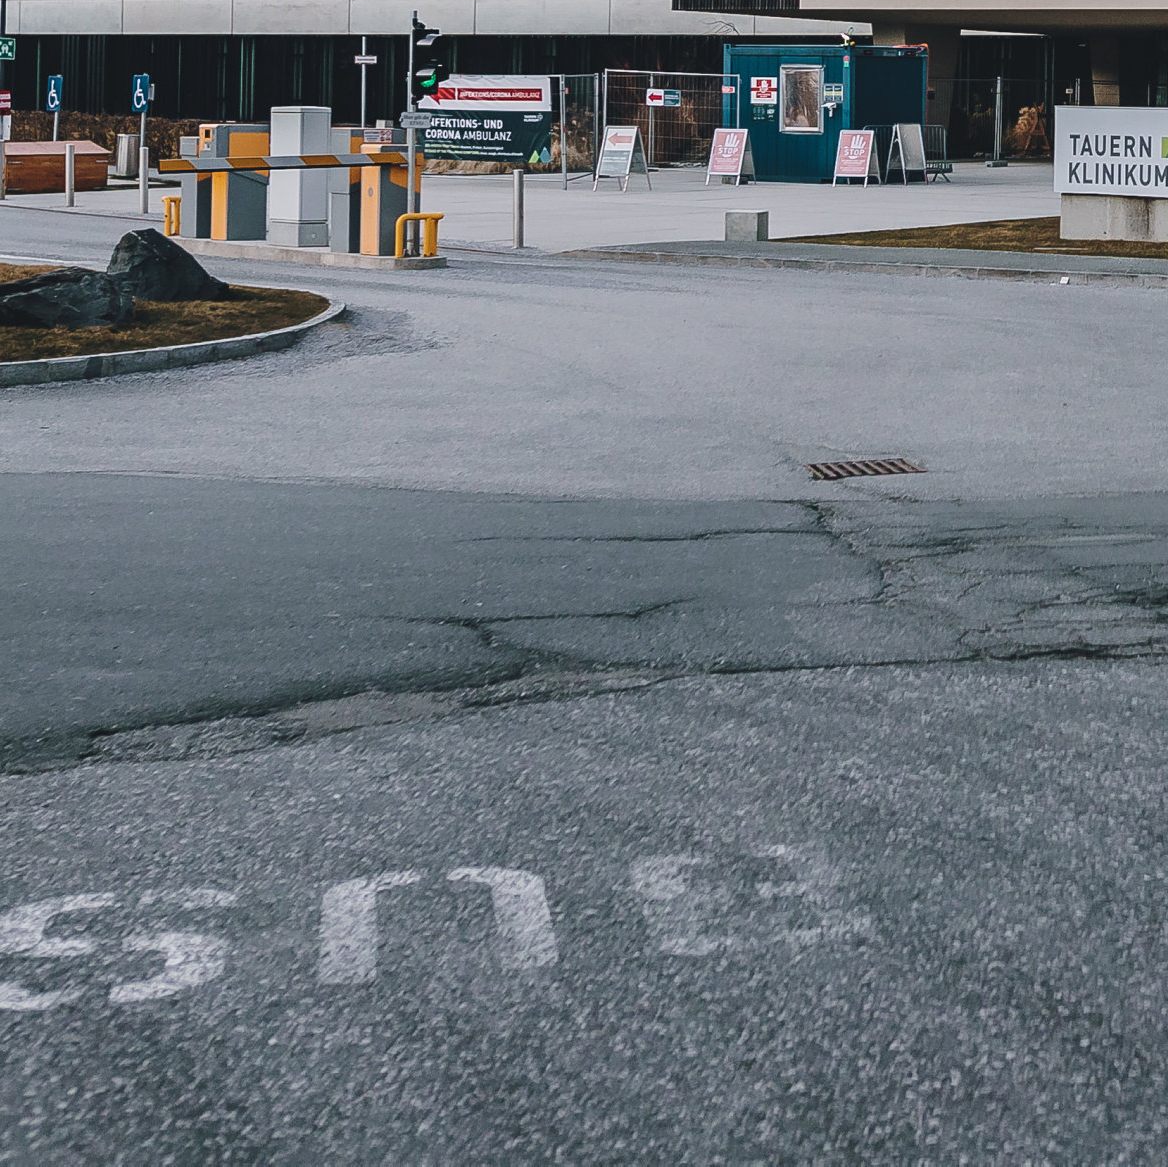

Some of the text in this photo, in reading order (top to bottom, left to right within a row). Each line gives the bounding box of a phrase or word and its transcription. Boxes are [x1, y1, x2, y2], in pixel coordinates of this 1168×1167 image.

[430, 117, 503, 130] NFEKTIONS- UND
[425, 129, 512, 142] CORONA AMBULANZ
[844, 148, 865, 156] STOP
[1069, 134, 1152, 158] TAUERN
[1068, 162, 1168, 187] KLINIKUM
